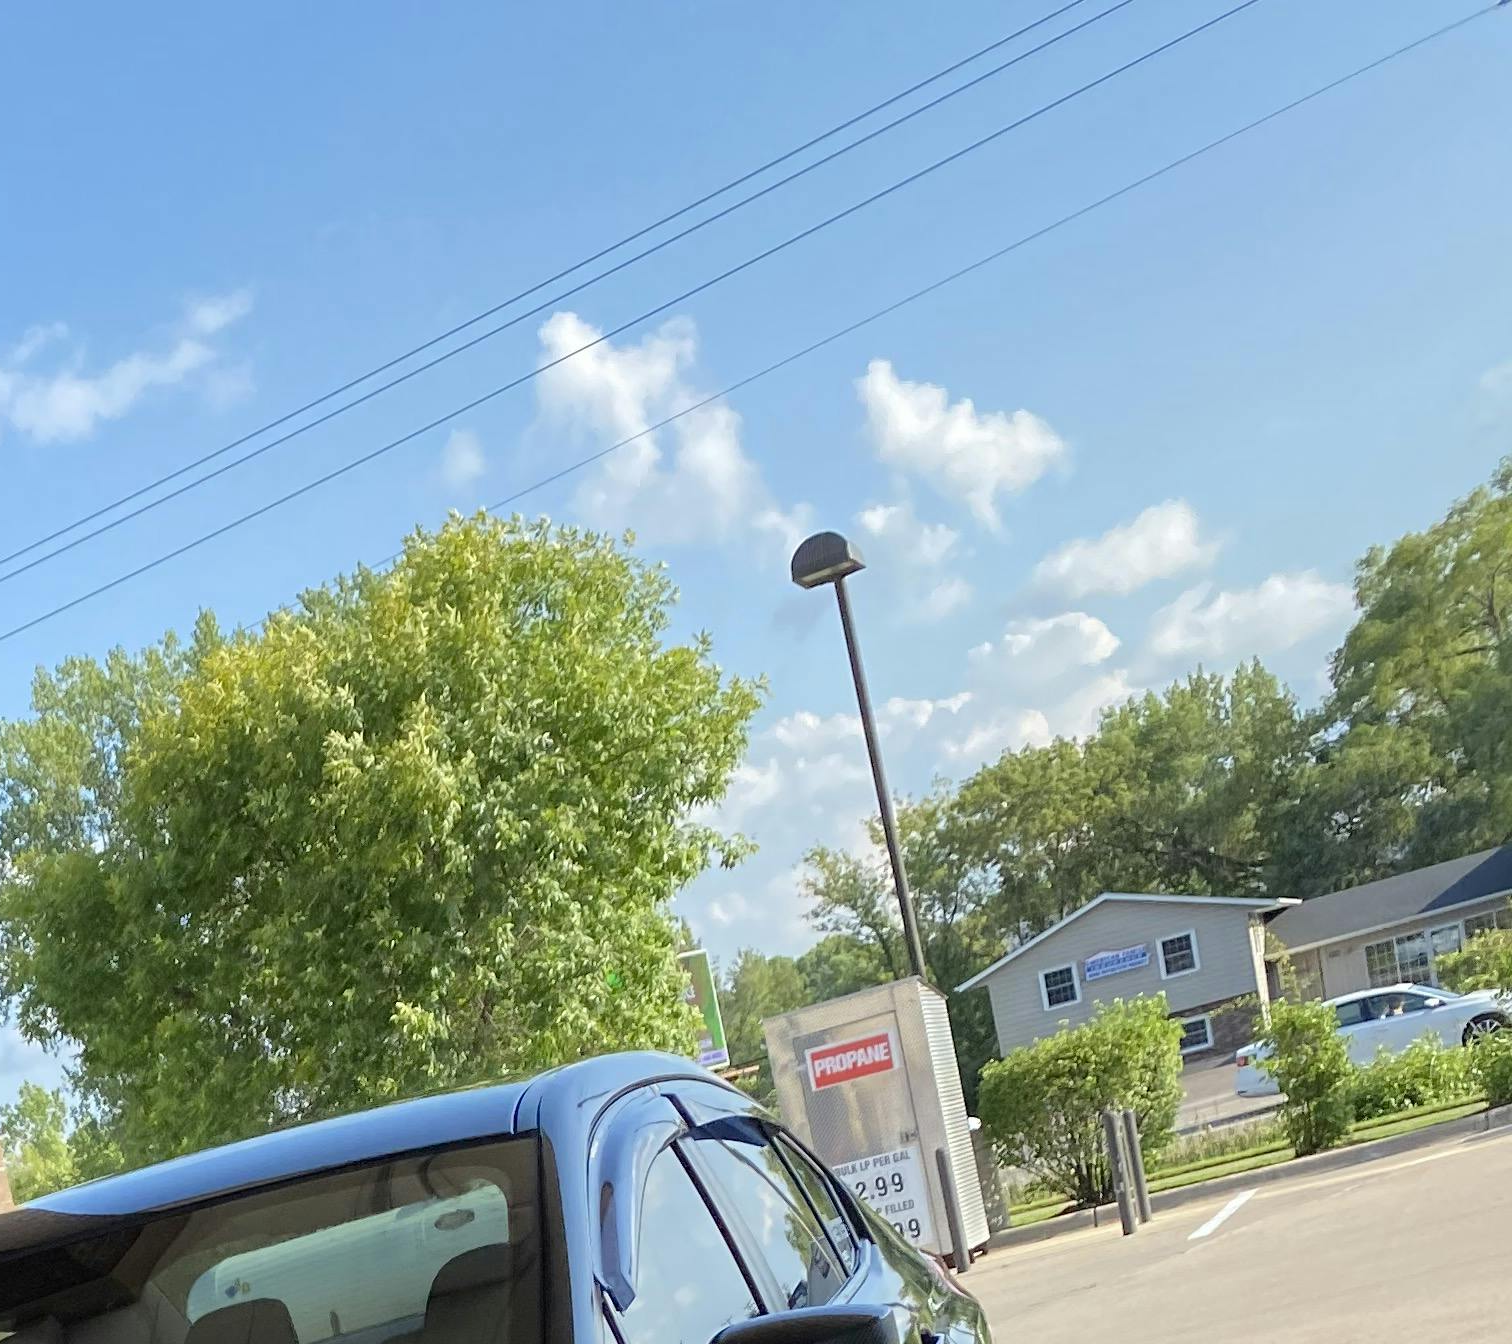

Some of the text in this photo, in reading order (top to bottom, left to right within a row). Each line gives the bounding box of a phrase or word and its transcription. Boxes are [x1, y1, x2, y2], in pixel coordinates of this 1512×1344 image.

[813, 1042, 891, 1078] PROPANE
[859, 1160, 871, 1172] LP
[873, 1156, 891, 1168] PER
[893, 1150, 911, 1162] GAL
[855, 1172, 905, 1201] 2.99
[885, 1199, 915, 1216] FILLED
